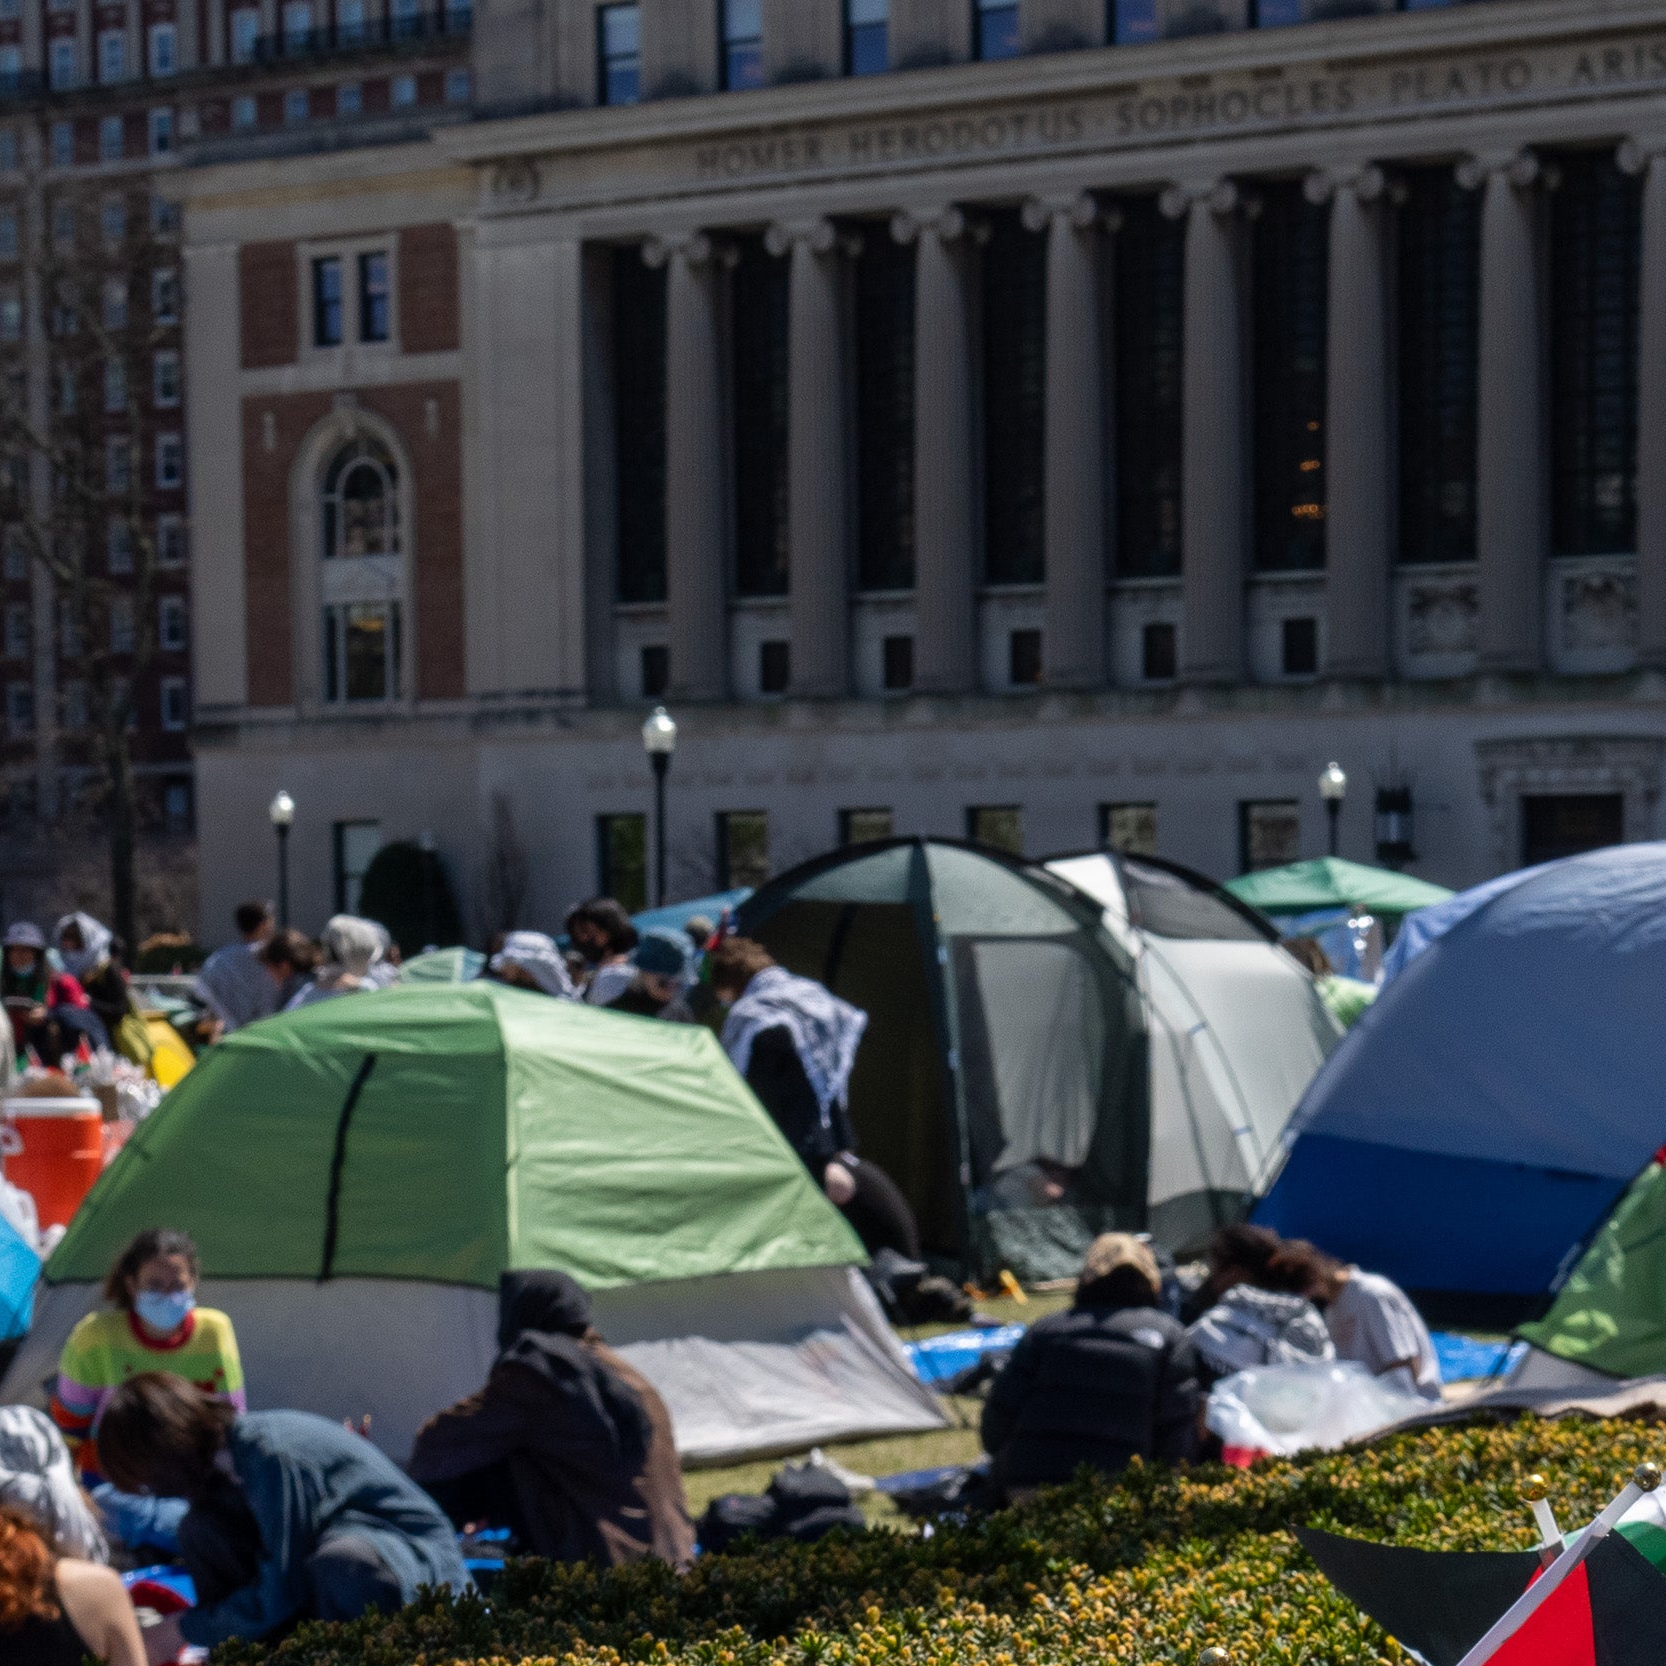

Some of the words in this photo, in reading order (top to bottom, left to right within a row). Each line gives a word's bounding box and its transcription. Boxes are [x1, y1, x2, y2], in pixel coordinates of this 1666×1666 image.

[697, 132, 823, 179] HOMER
[852, 107, 1085, 163] HERODOTUS
[1117, 77, 1353, 137] SOPHOCLES
[1389, 57, 1532, 106] PLATO
